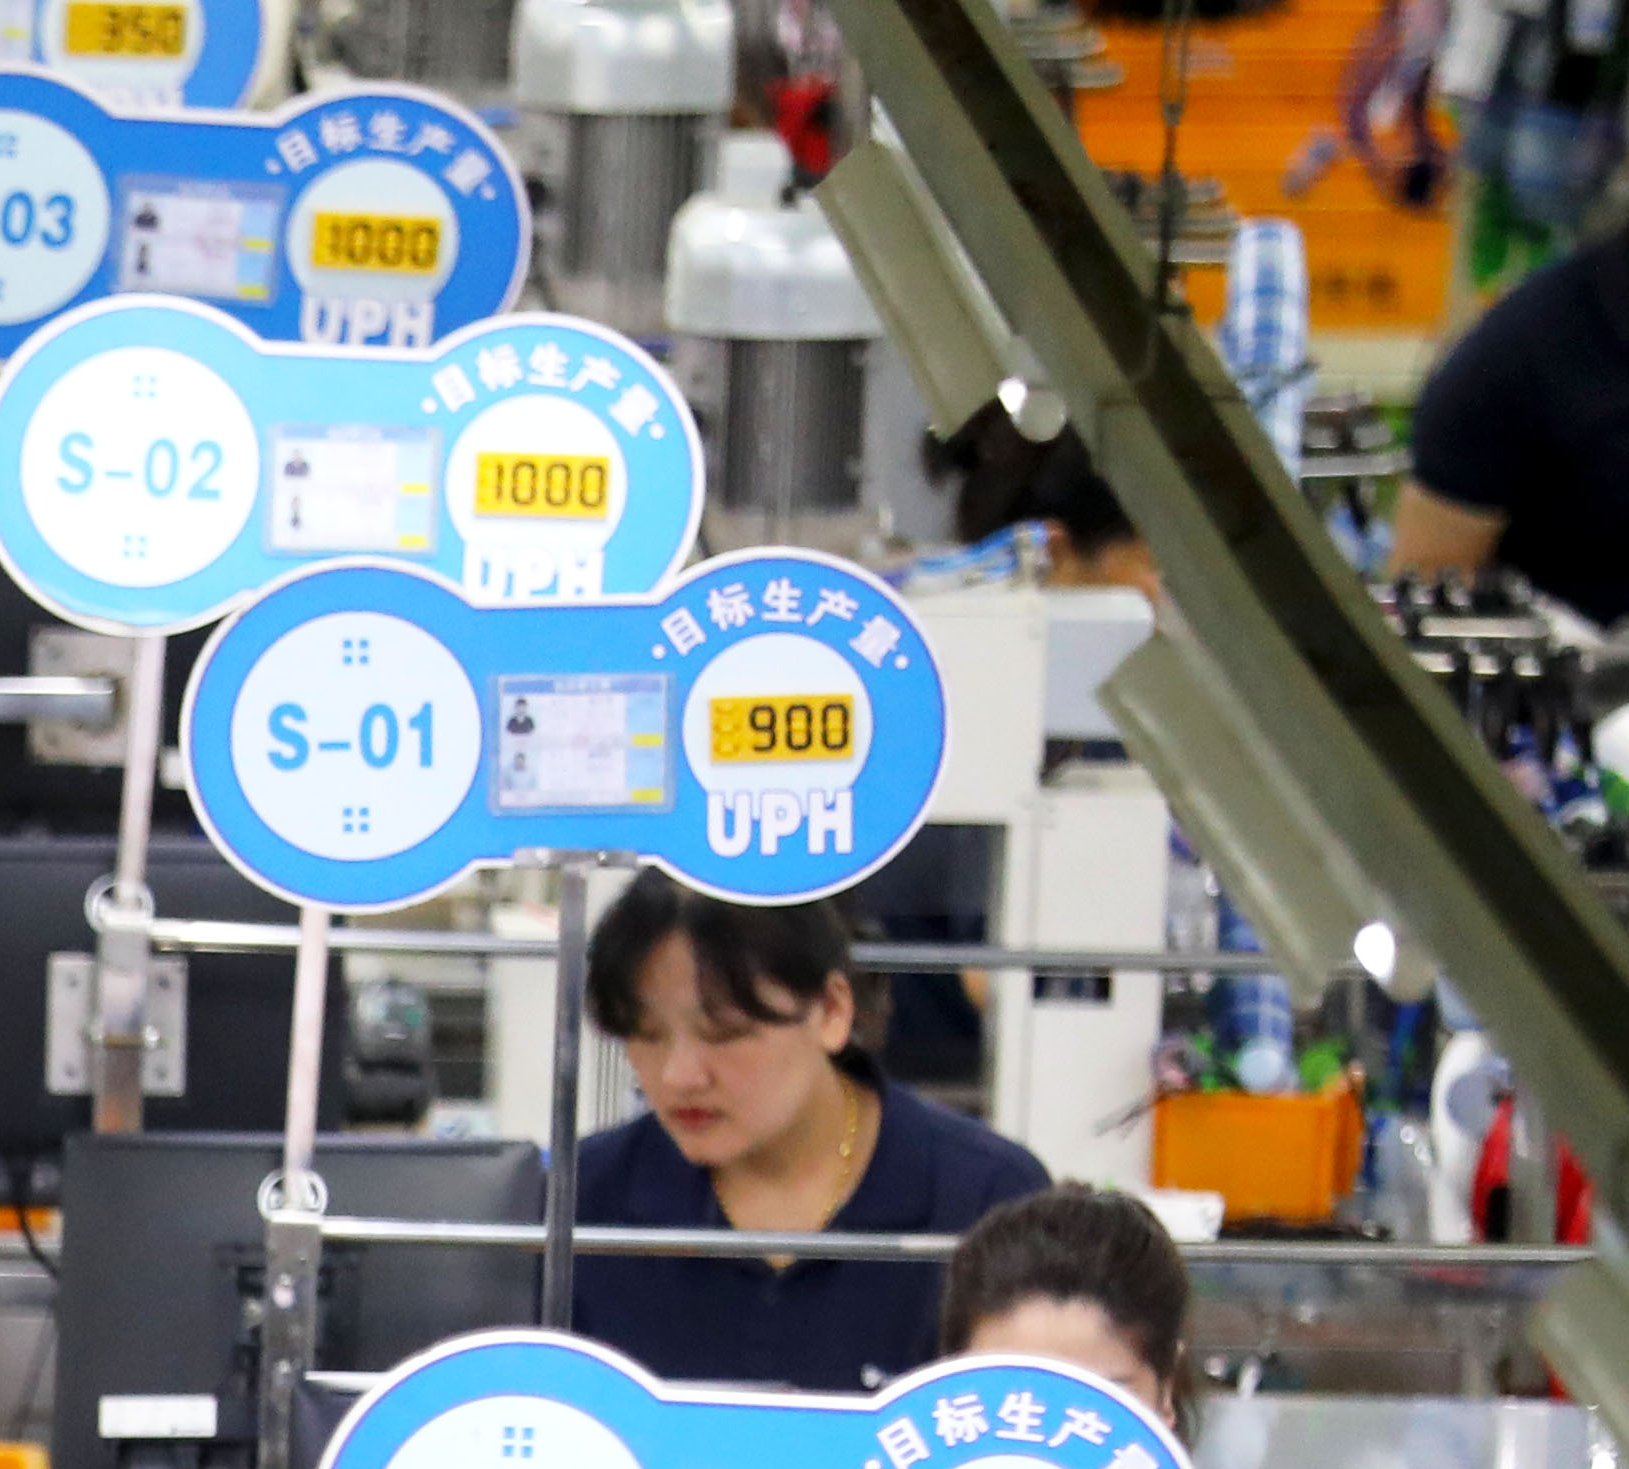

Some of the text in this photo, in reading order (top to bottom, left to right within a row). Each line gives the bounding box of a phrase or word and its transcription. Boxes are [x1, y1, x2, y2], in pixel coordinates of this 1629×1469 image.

[277, 110, 485, 199] 目标生产量
[324, 215, 438, 269] 1000
[300, 296, 434, 347] UPH
[431, 345, 663, 440] 目标生产量
[55, 431, 223, 503] S-02
[484, 457, 609, 518] 1000
[462, 540, 603, 598] UPH
[660, 578, 901, 670] 目标生产量
[266, 700, 436, 773] S-01
[749, 700, 850, 756] 900
[708, 792, 854, 857] UPH
